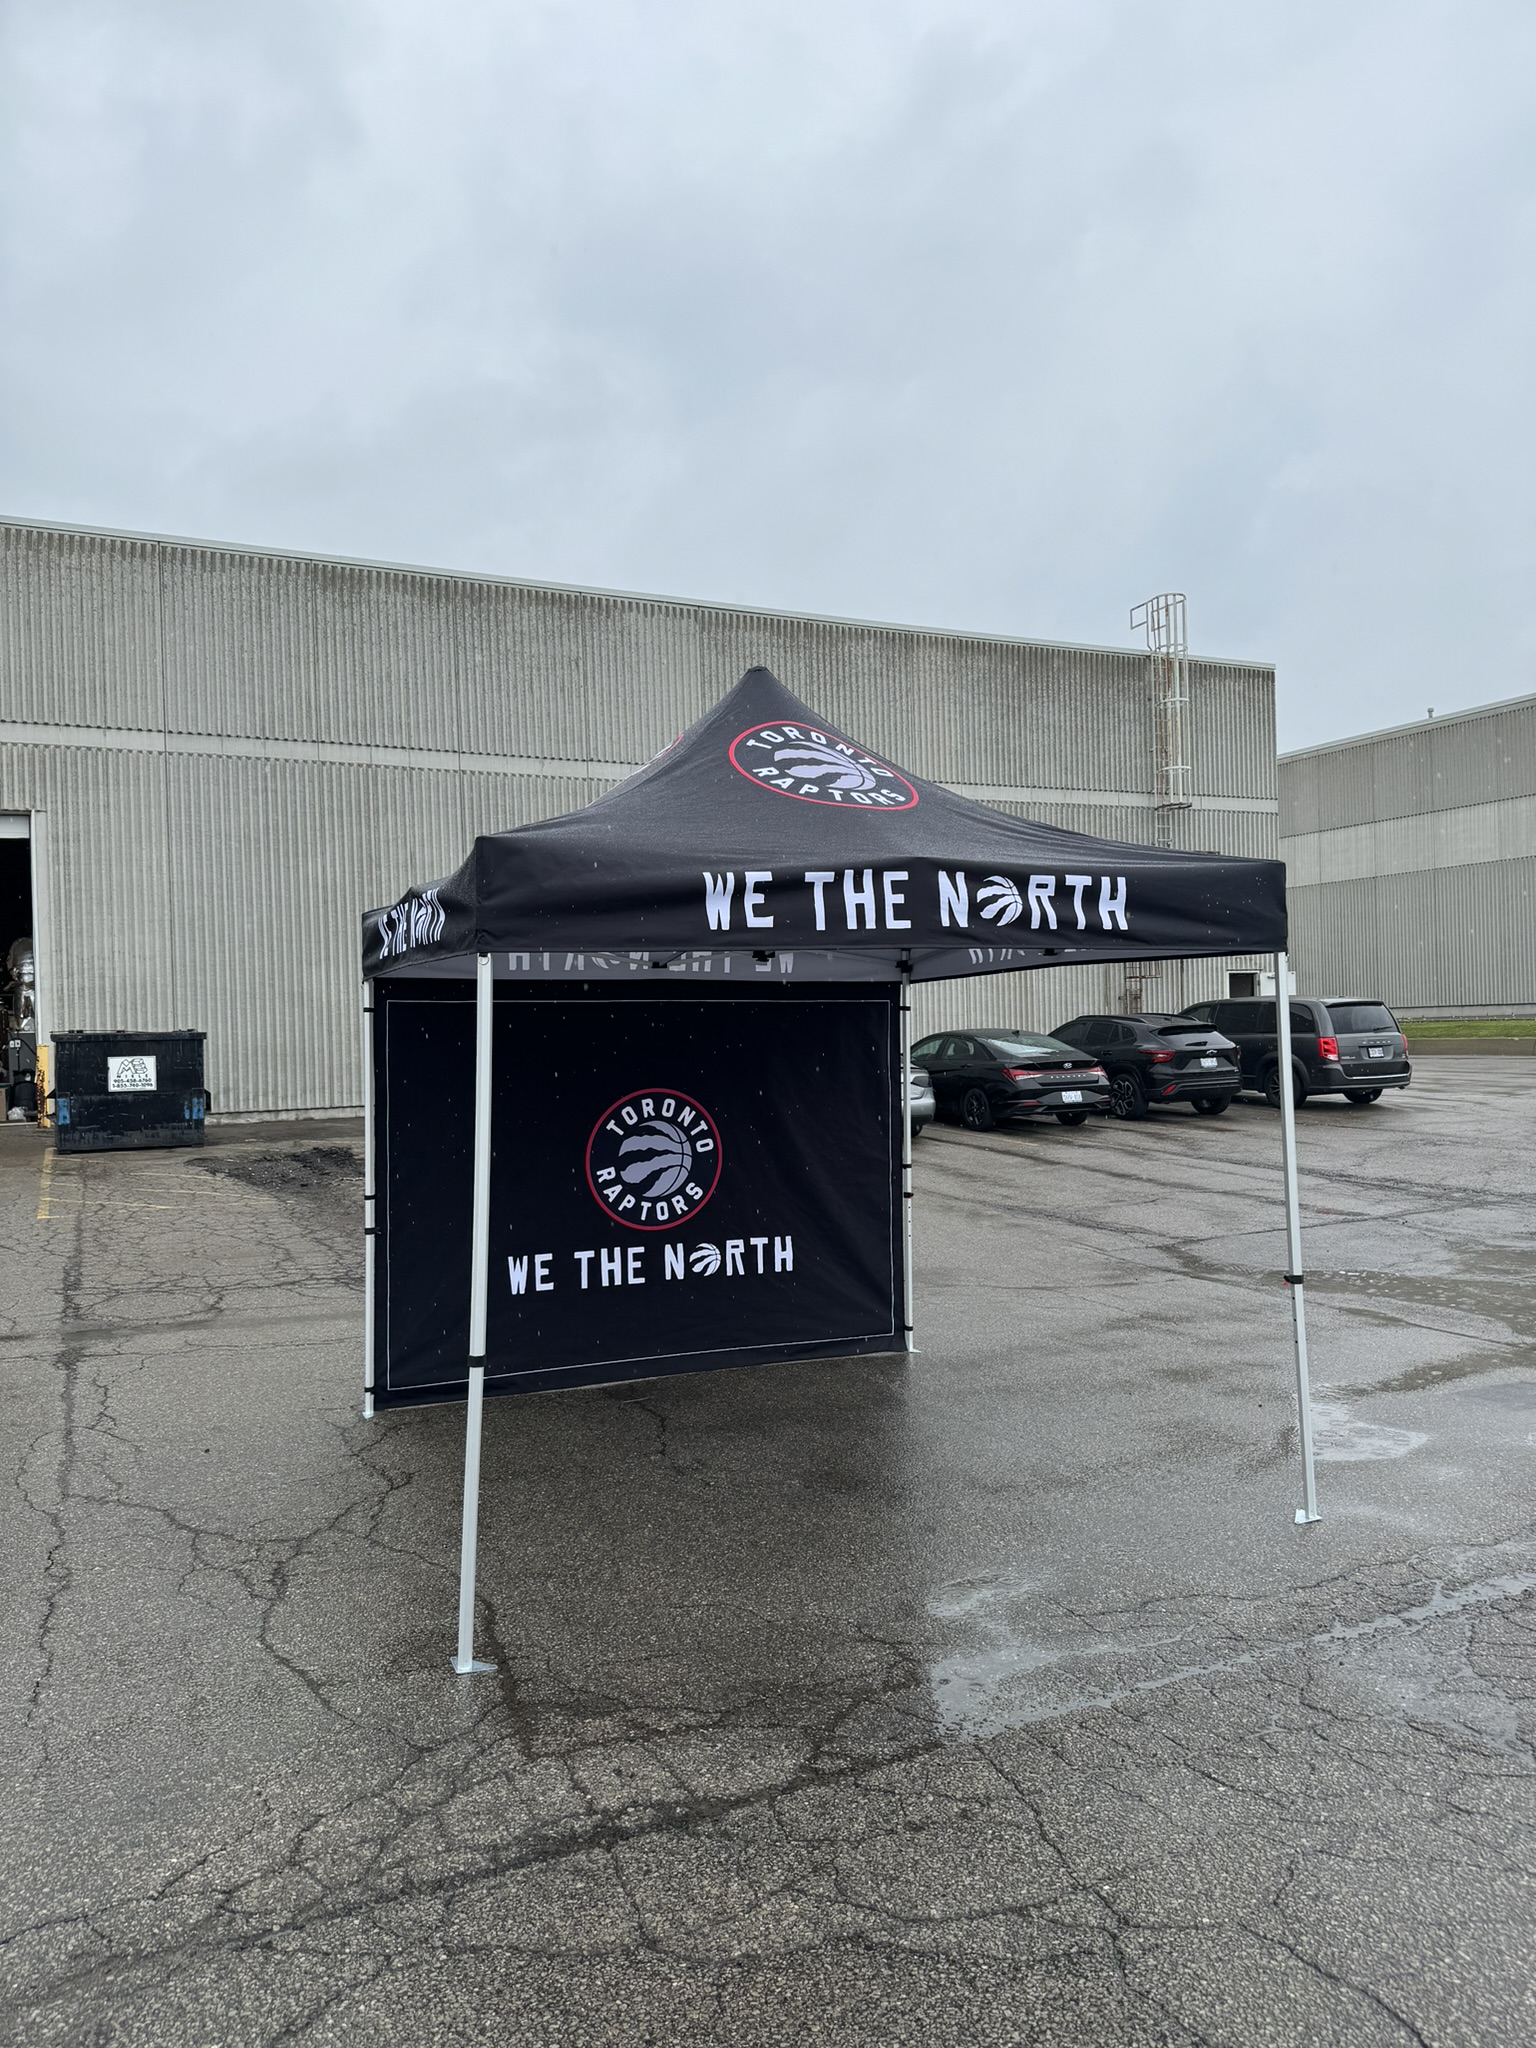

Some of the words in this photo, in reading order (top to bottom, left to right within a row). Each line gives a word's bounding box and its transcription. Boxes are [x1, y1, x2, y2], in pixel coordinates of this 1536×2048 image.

[746, 726, 894, 778] TORONTO
[752, 766, 906, 806] RAPTORS
[702, 870, 775, 931] WE
[804, 868, 912, 931] THE
[605, 1098, 715, 1153] TORONTO
[596, 1166, 704, 1221] RAPTORS
[507, 1253, 555, 1296] WE
[573, 1246, 646, 1289] THE
